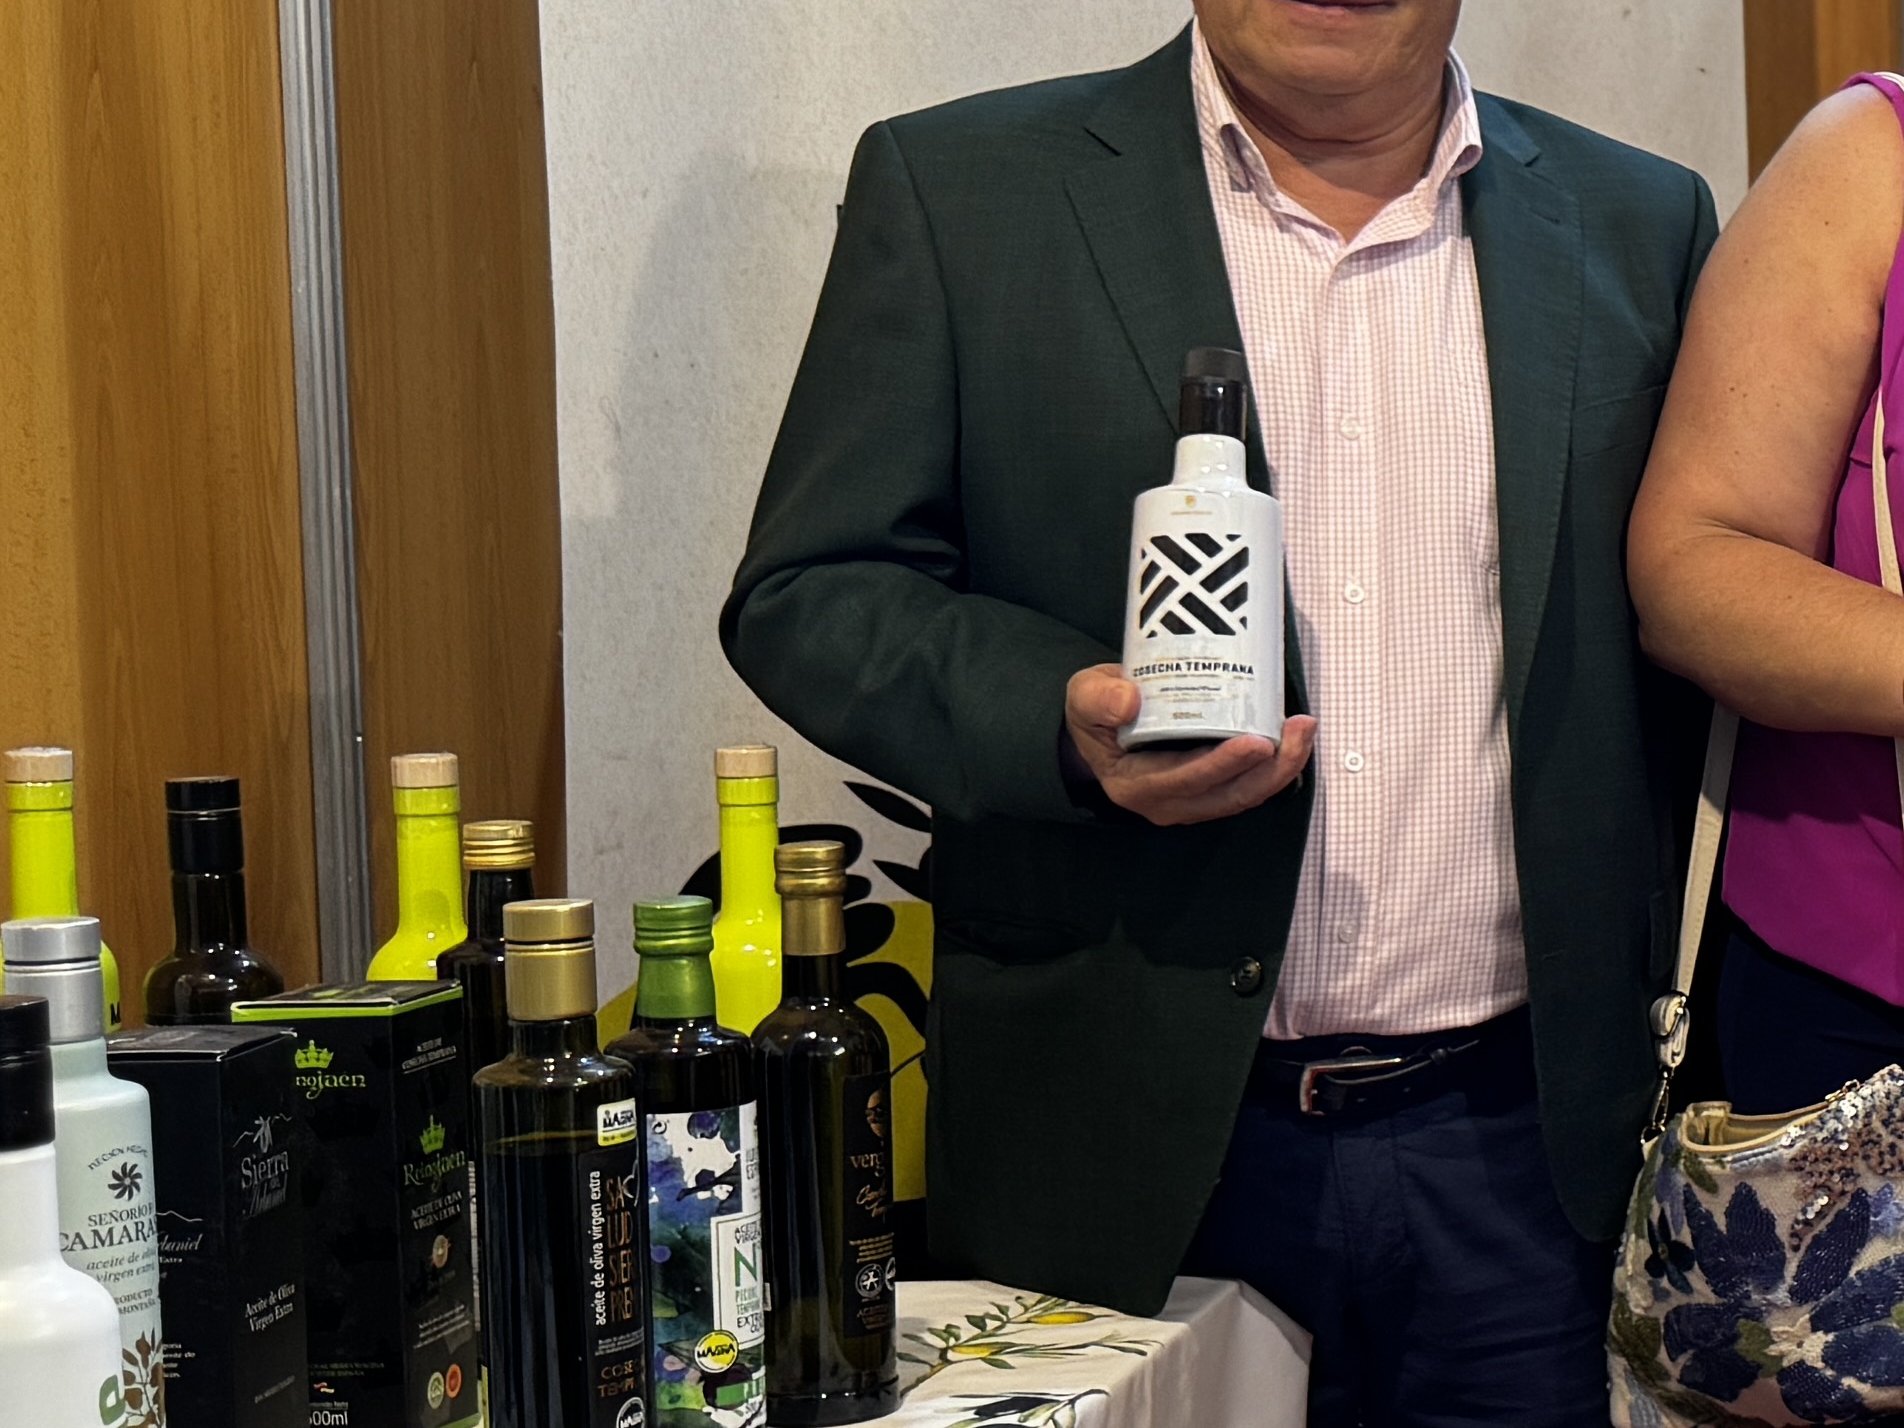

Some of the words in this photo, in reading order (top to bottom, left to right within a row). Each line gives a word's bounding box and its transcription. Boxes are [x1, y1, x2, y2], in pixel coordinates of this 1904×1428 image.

[589, 1170, 601, 1201] extra
[59, 1215, 158, 1253] CAMARA
[588, 1203, 606, 1241] virgen
[589, 1242, 605, 1271] oliva
[590, 1272, 605, 1288] de
[590, 1290, 606, 1326] aceite
